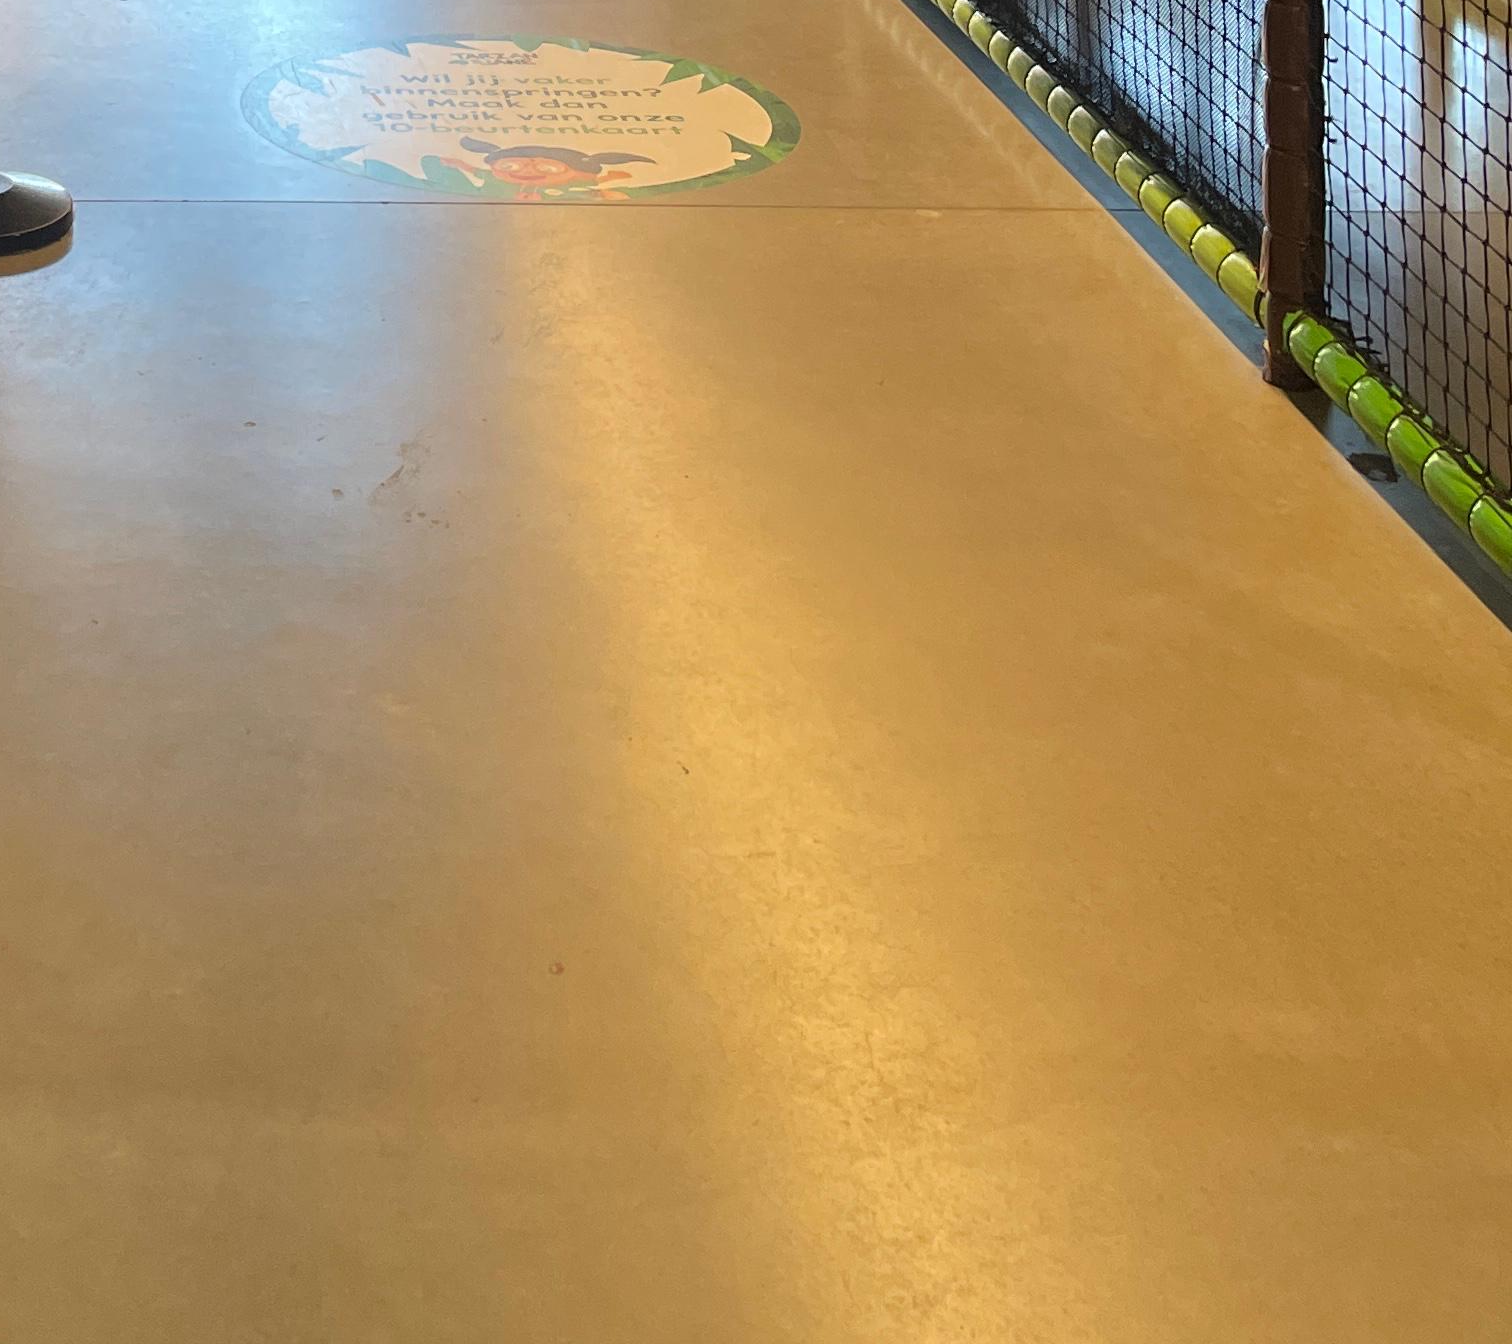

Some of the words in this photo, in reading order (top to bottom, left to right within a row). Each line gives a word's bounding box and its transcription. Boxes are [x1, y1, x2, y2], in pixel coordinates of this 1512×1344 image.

[399, 74, 450, 83] Wil
[466, 74, 499, 86] jij
[514, 75, 612, 85] vaker
[360, 85, 662, 99] binnenspringen?
[427, 97, 526, 108] Maak
[539, 98, 608, 109] dan
[362, 110, 504, 122] gebruik
[516, 113, 583, 121] van
[597, 114, 685, 122] onze
[372, 122, 684, 135] 10-beurtenkaart
